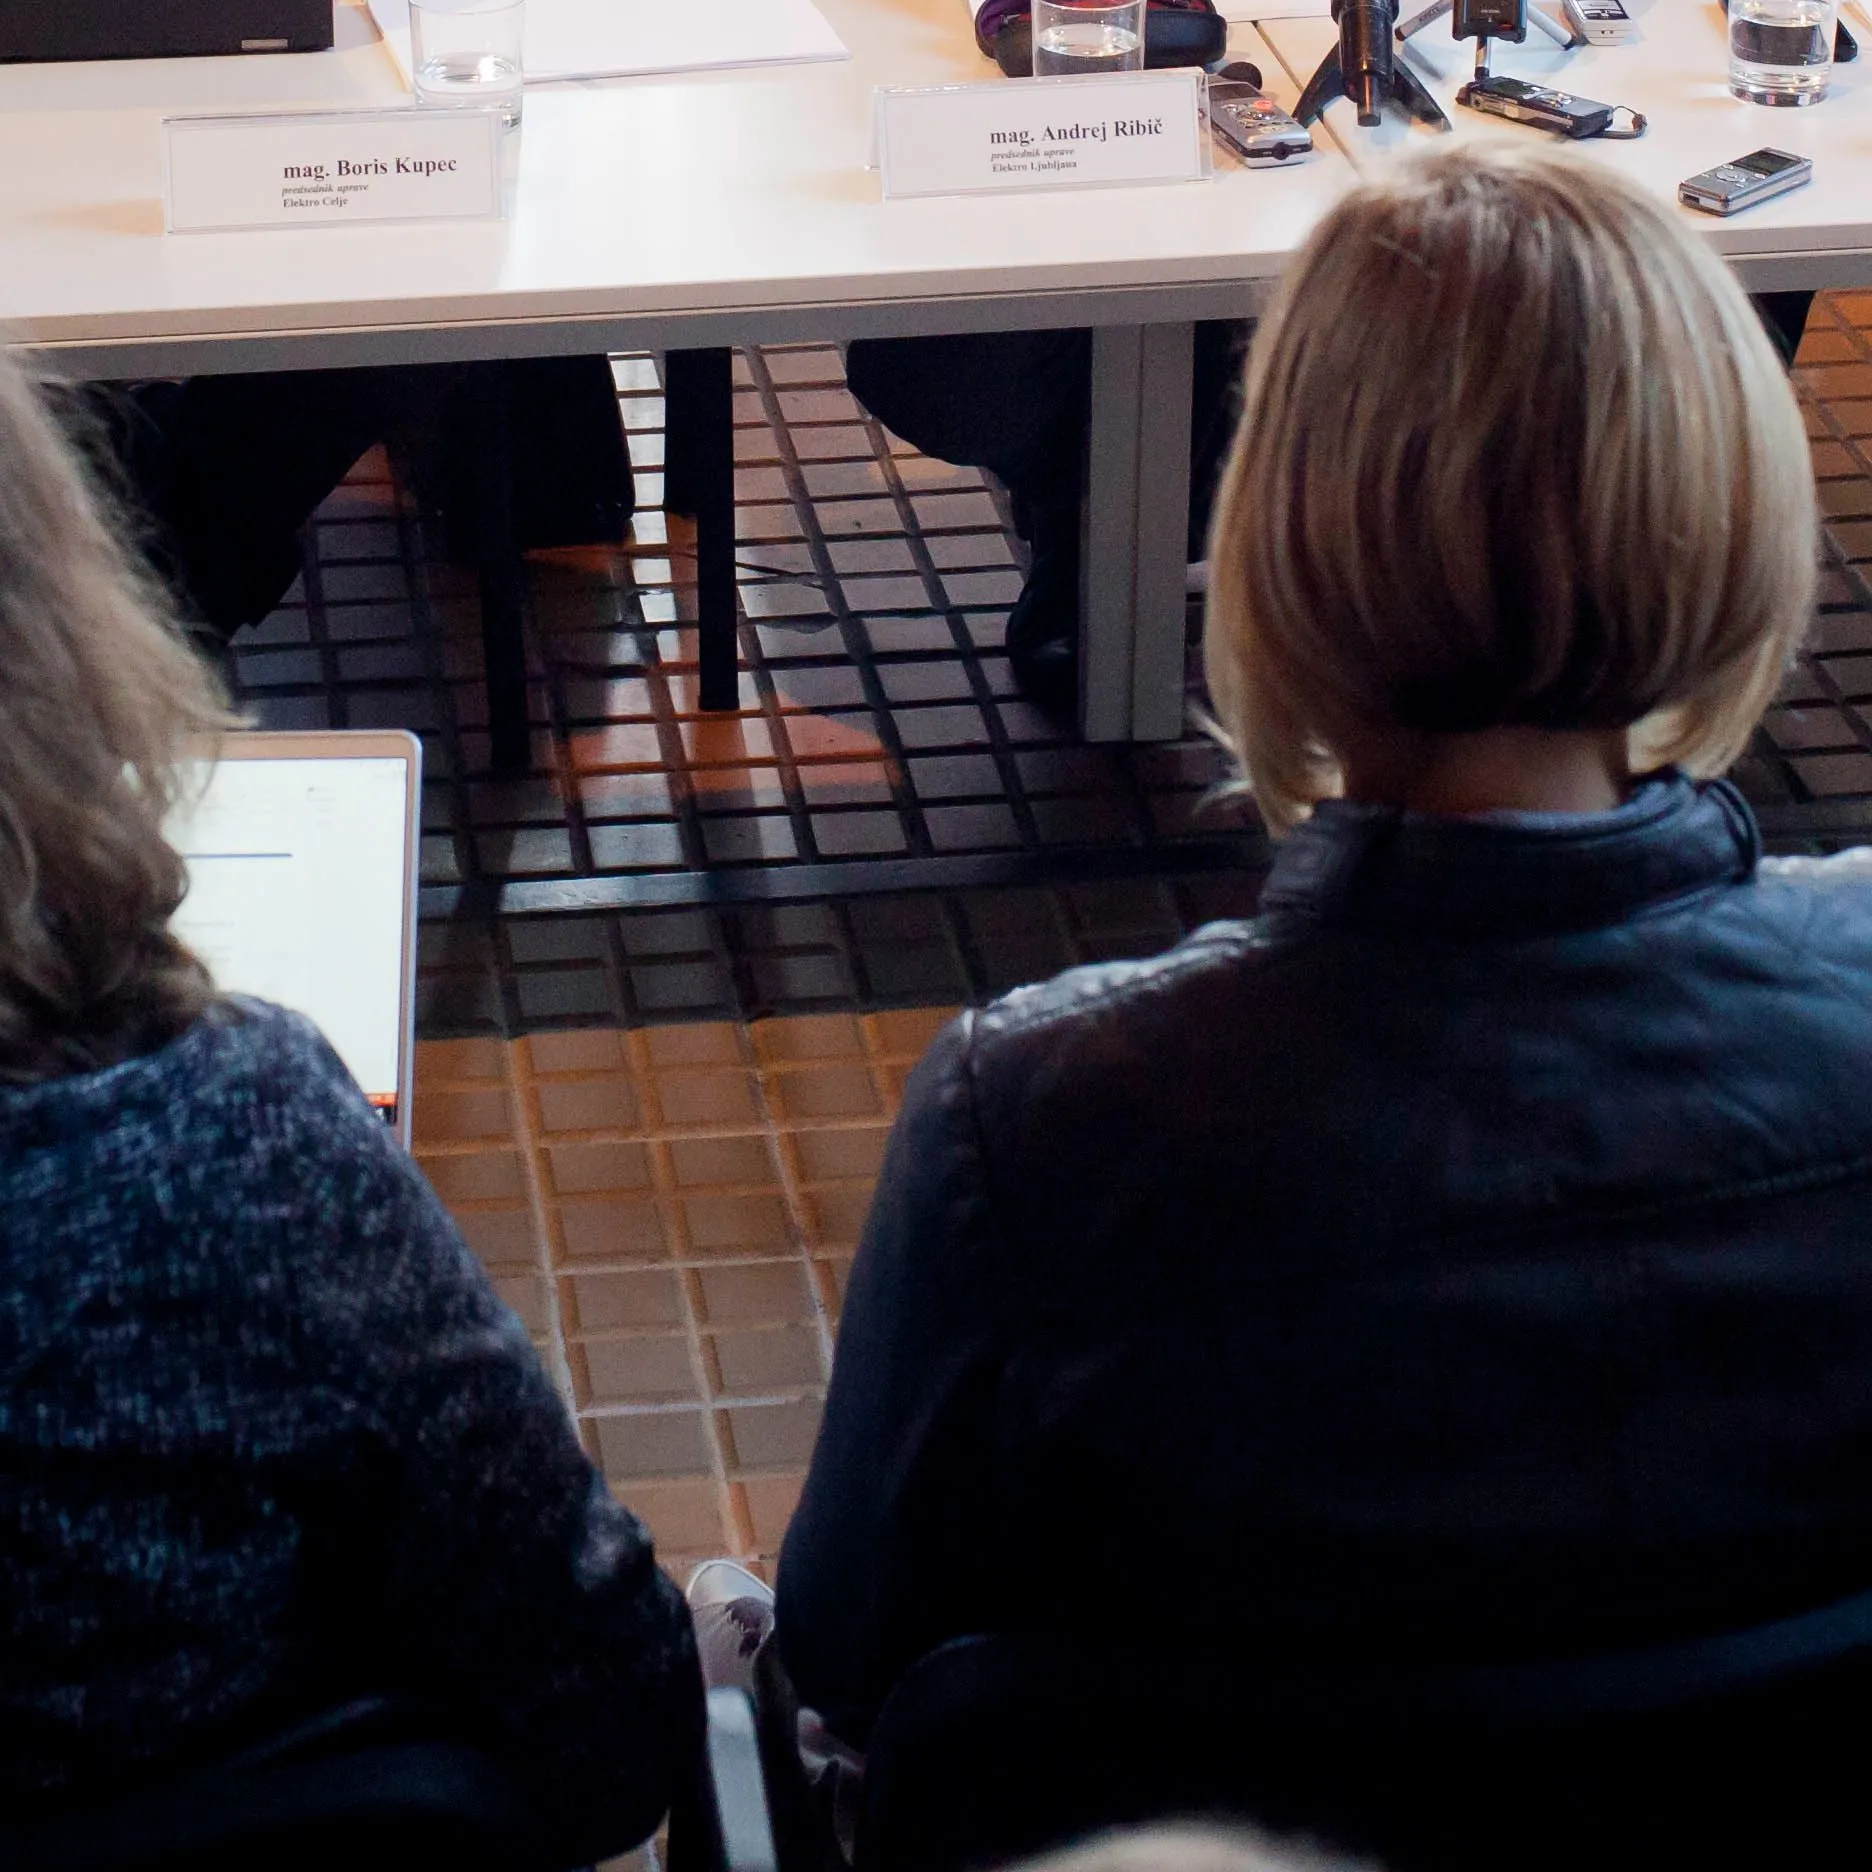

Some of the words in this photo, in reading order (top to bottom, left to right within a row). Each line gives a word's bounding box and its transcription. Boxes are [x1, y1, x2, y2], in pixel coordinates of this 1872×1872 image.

[990, 127, 1035, 146] mag.
[1041, 121, 1108, 143] Andrej
[1114, 117, 1164, 138] Ribič
[283, 163, 330, 182] mag.
[337, 159, 388, 177] Boris
[395, 156, 458, 179] Kupec
